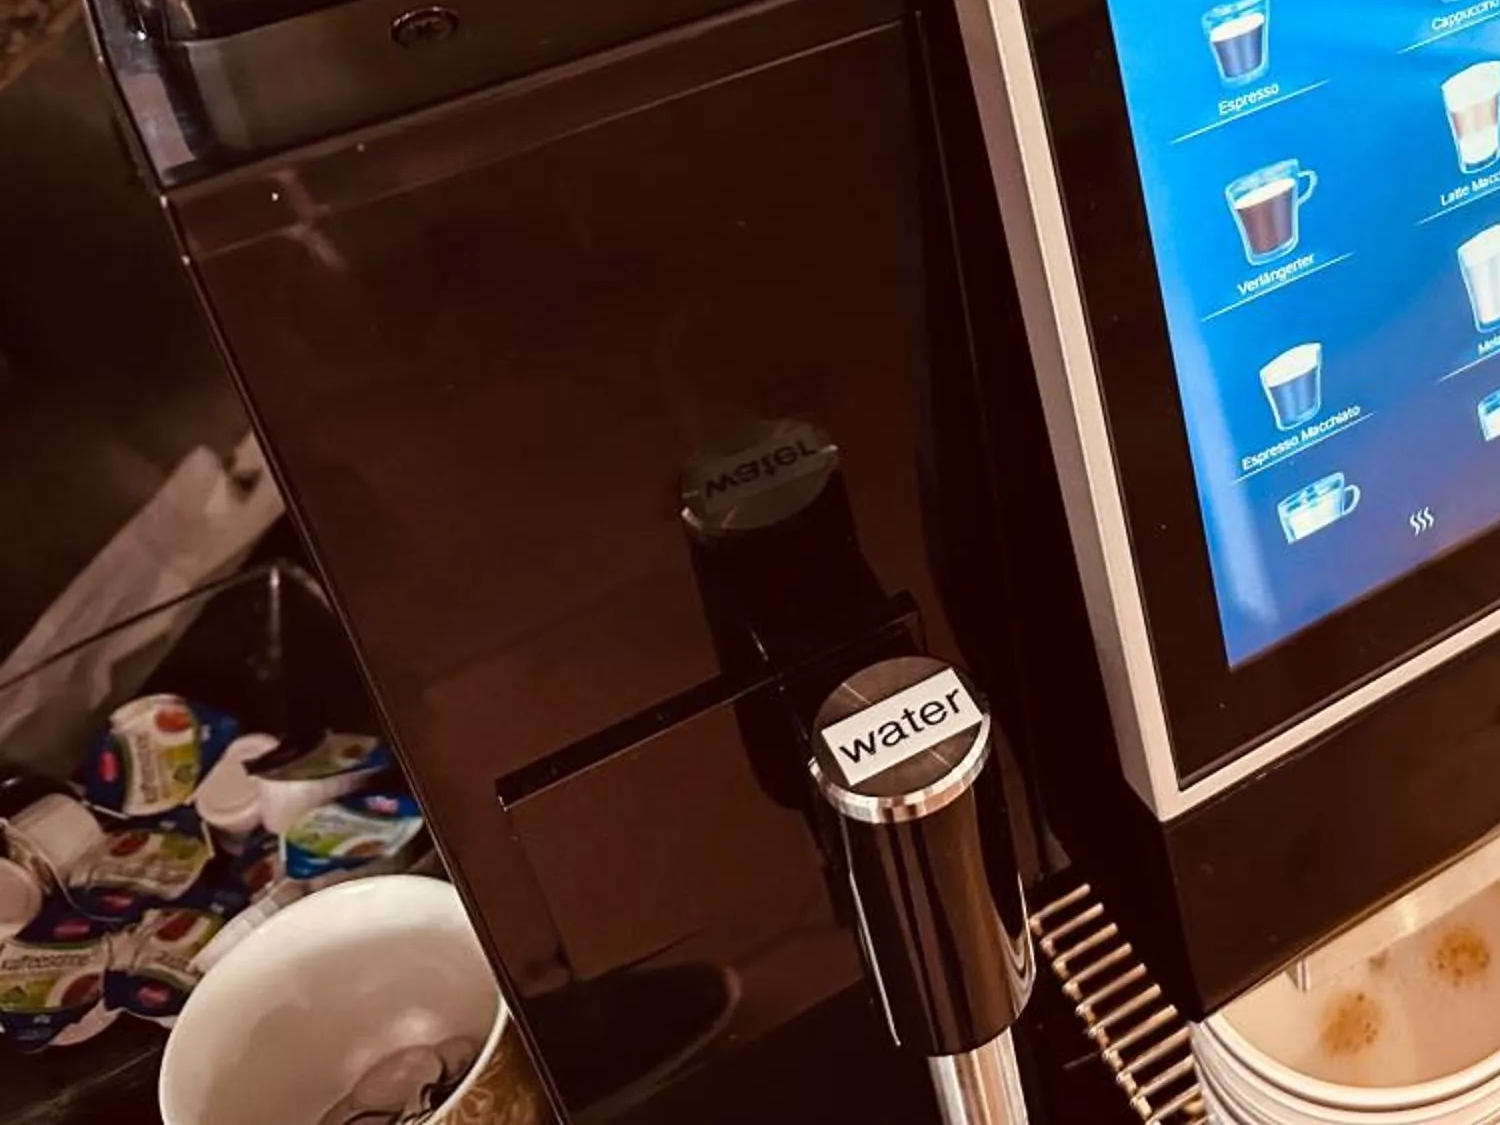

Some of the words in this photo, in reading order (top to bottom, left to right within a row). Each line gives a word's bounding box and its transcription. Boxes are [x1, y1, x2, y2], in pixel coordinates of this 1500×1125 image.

[1218, 83, 1280, 115] Espresso
[1440, 185, 1470, 206] Latte
[1237, 253, 1315, 295] Verlängerter
[1242, 435, 1299, 470] Espresso
[1301, 404, 1361, 441] Macchiato
[839, 686, 962, 764] water
